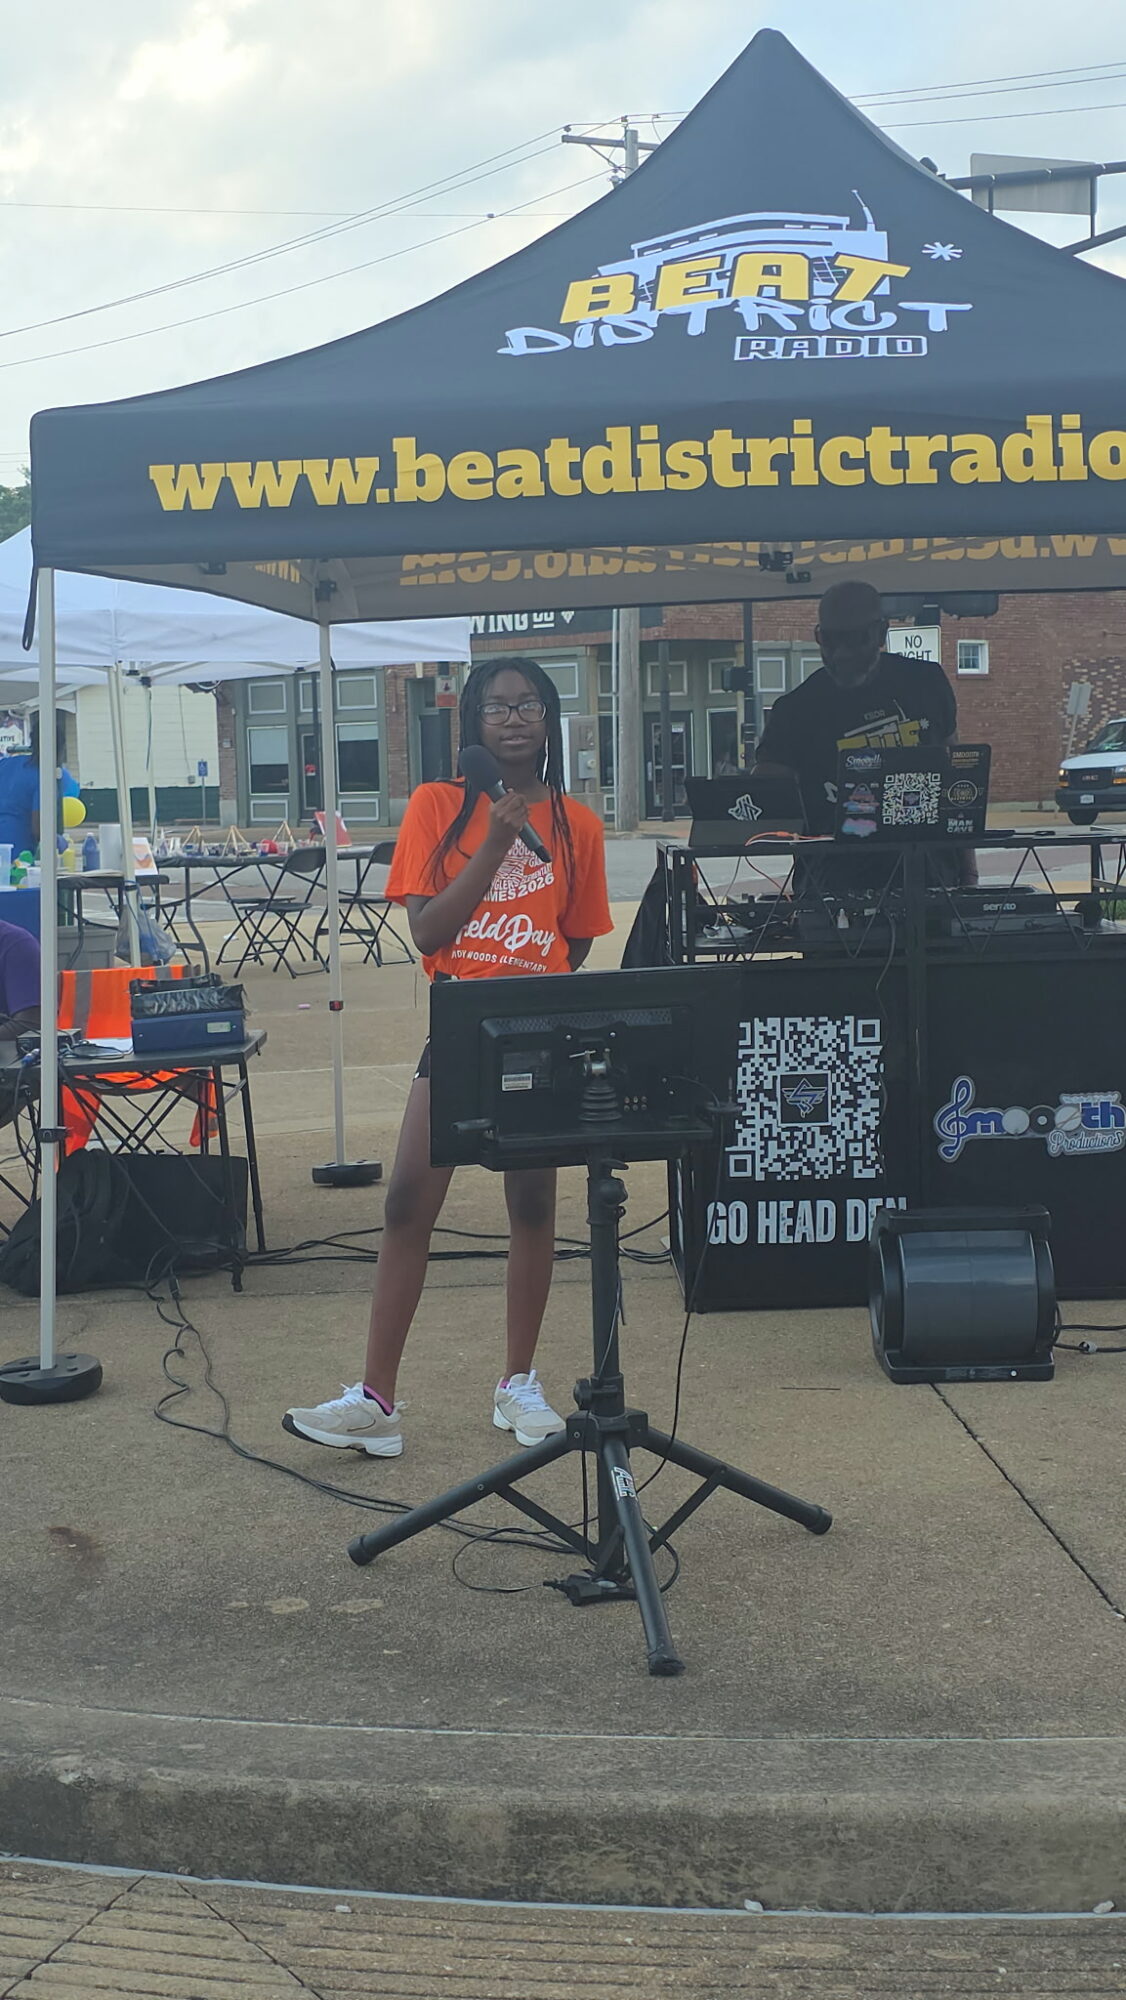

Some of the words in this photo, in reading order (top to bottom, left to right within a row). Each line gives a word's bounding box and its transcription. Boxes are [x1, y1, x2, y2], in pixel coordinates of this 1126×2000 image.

[560, 251, 911, 324] BEAT
[734, 335, 928, 361] RADIO
[148, 414, 1126, 512] www.beatdistrictradio
[905, 634, 923, 649] NO
[947, 818, 974, 827] MAN
[517, 872, 555, 898] 2026
[503, 914, 556, 957] Day
[706, 1200, 748, 1245] GO
[757, 1199, 837, 1244] HEAD
